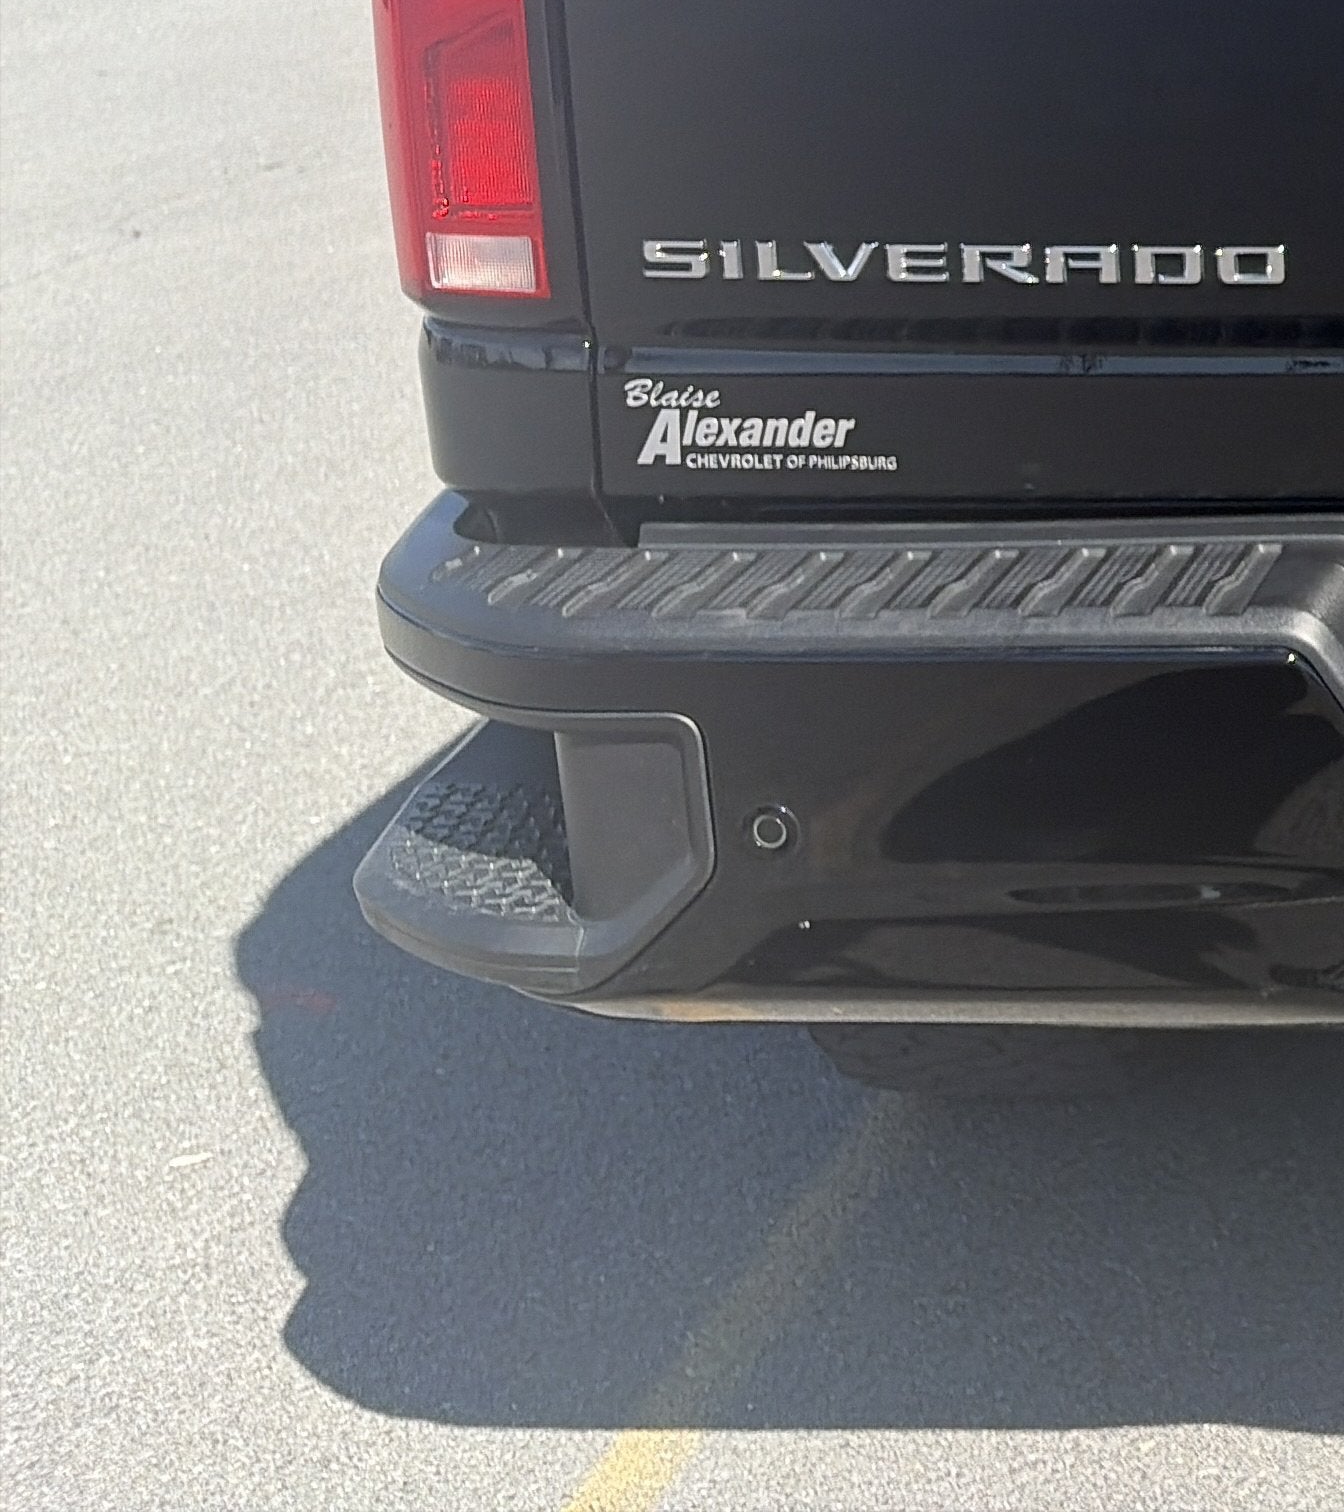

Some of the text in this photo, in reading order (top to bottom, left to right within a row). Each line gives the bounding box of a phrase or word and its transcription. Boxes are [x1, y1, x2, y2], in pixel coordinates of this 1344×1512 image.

[641, 238, 1287, 286] SILVERADO
[623, 377, 721, 409] Blaise
[636, 407, 856, 466] Alexander
[685, 452, 898, 472] CHEVROLET OF PHILIPSBURG
